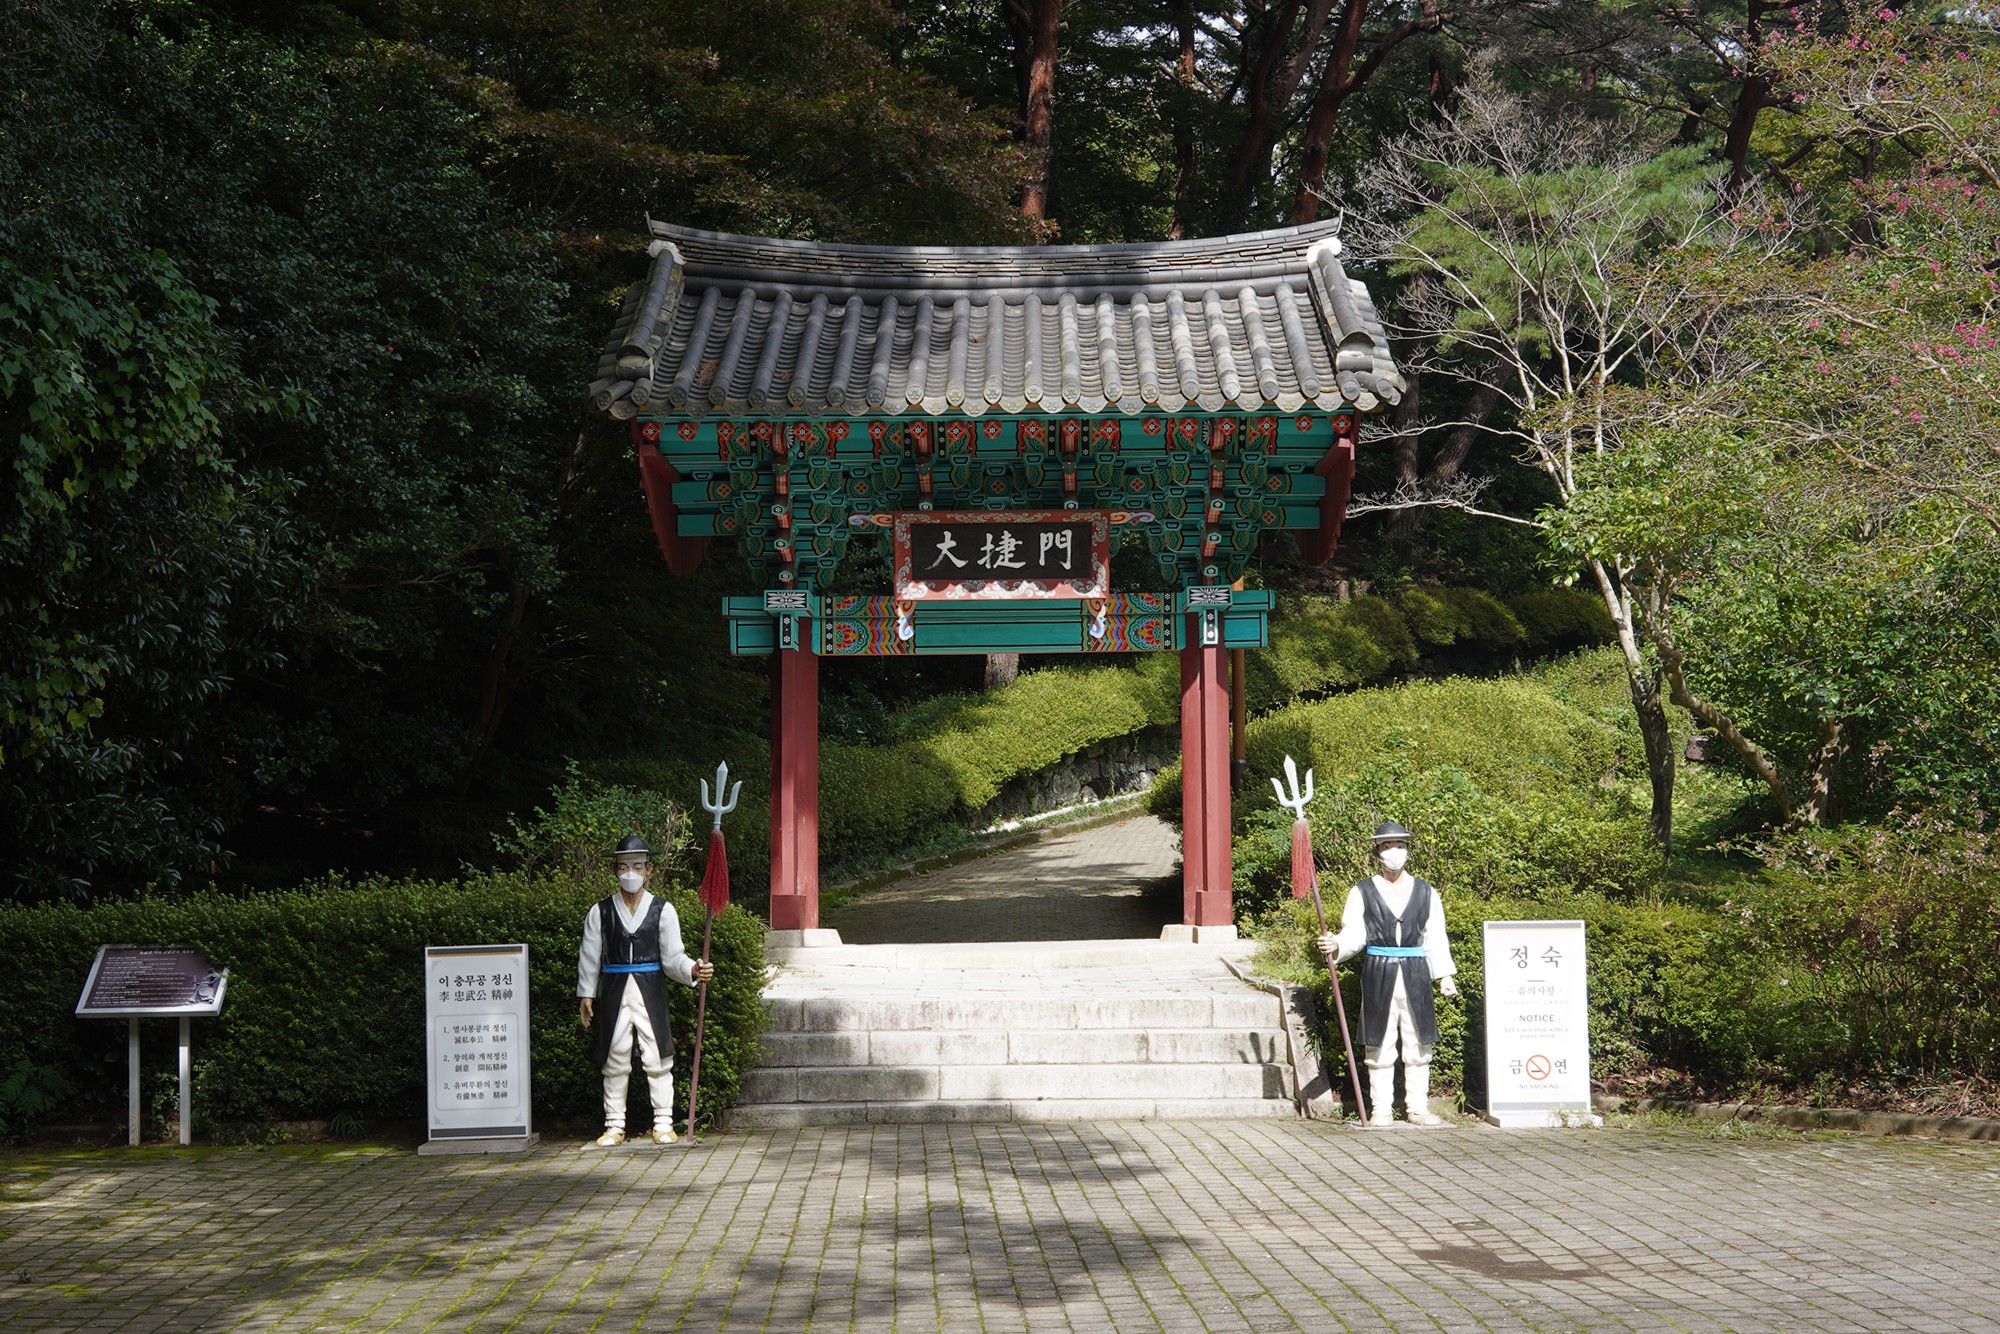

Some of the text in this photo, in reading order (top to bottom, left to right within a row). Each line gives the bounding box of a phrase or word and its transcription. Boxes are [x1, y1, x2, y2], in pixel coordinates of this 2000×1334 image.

[925, 528, 1073, 571] 大捷門
[453, 975, 487, 987] 충무공
[491, 973, 512, 986] 정신
[1519, 1014, 1555, 1022] NOTICE
[492, 1024, 507, 1032] 정신
[493, 1080, 508, 1089] 정신
